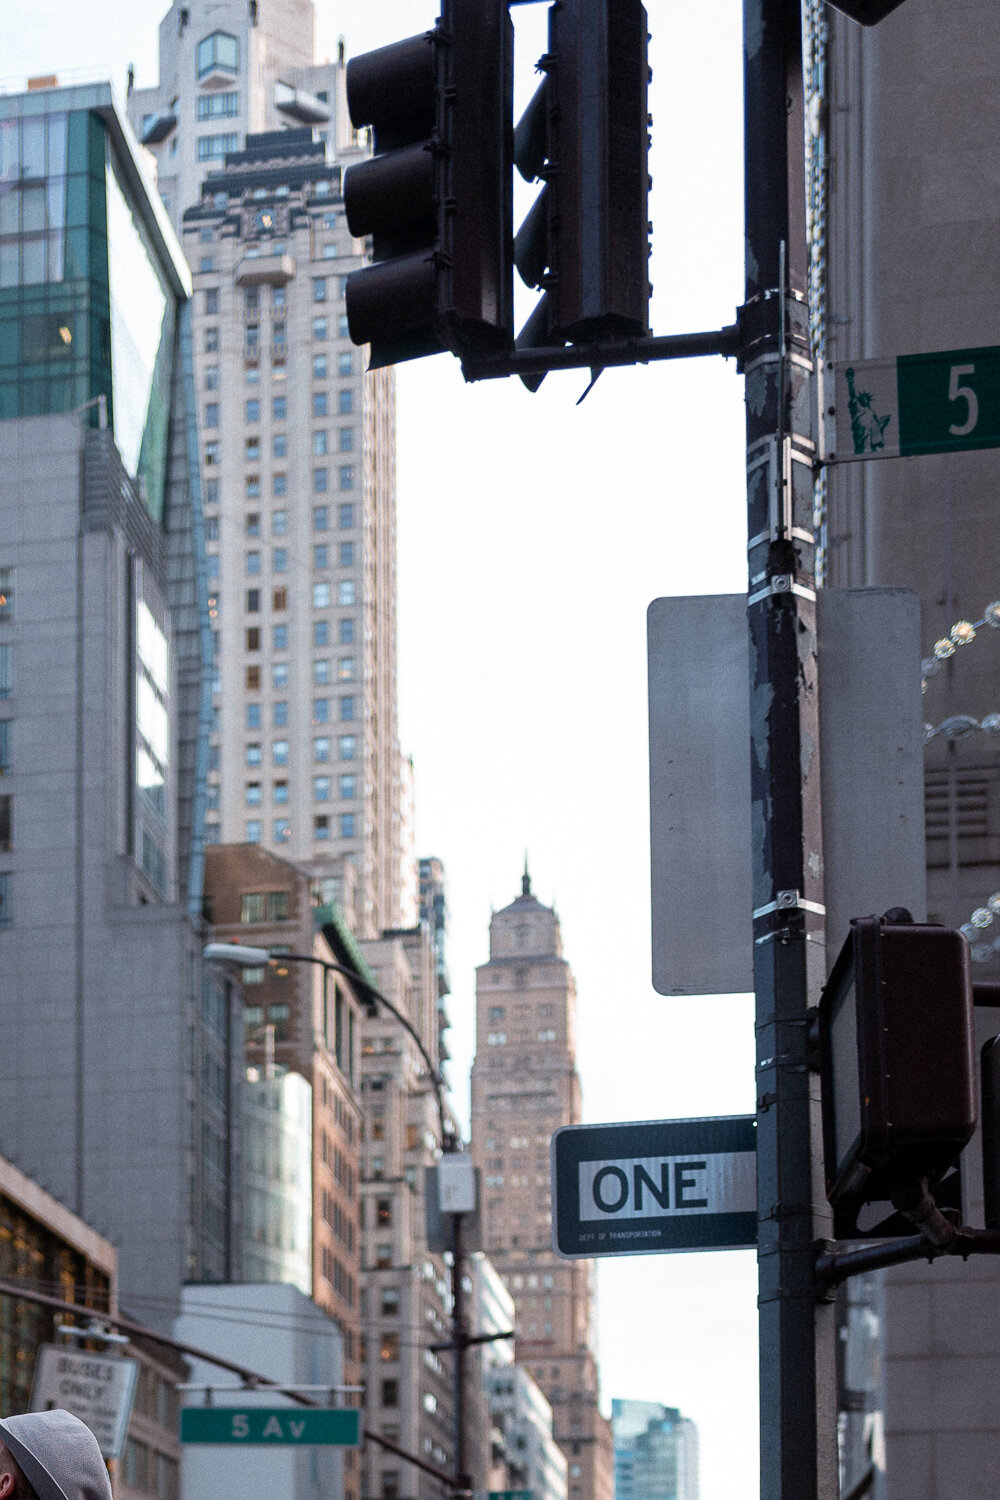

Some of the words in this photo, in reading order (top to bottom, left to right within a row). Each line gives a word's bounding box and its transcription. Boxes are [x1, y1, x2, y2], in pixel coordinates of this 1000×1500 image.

[947, 363, 979, 436] 5
[592, 1160, 709, 1214] ONE
[609, 1229, 662, 1239] TRANSPORTATION
[57, 1356, 116, 1381] BUSES
[60, 1378, 108, 1400] ONLY
[231, 1414, 250, 1438] 5
[262, 1415, 306, 1438] Av
